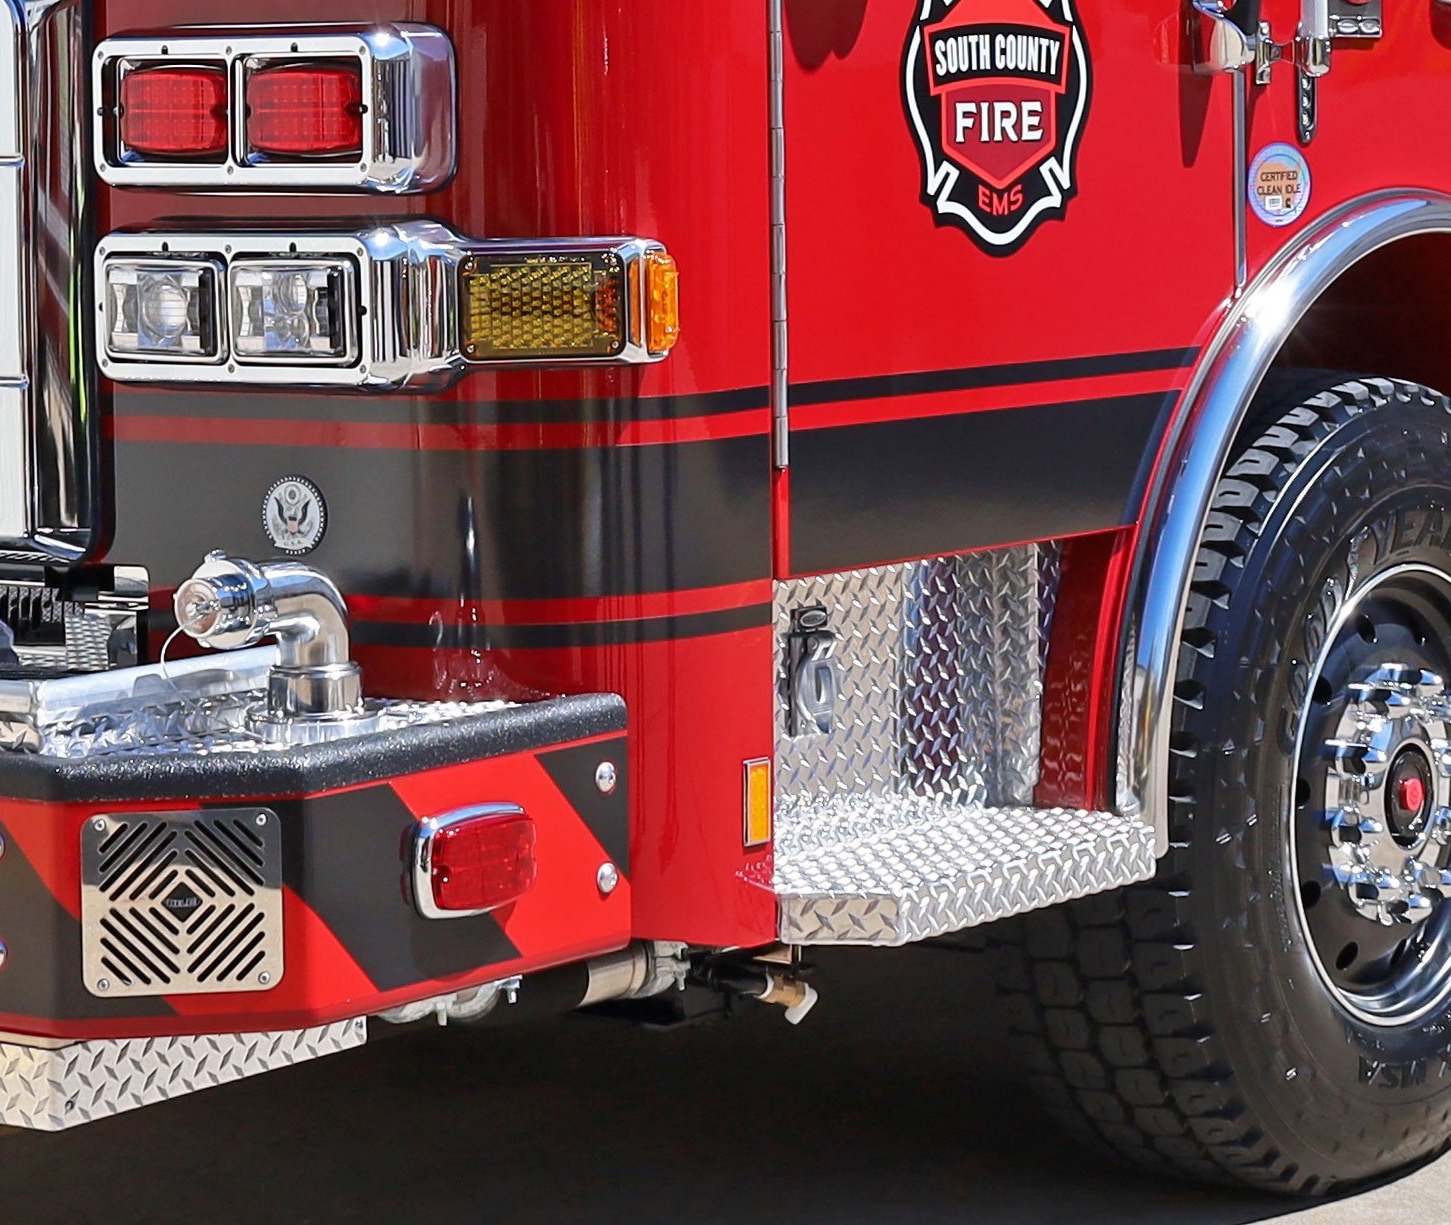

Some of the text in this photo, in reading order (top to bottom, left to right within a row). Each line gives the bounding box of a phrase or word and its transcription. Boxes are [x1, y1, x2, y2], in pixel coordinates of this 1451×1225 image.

[935, 34, 1060, 78] SOUTH COUNTY
[955, 101, 1043, 143] FIRE
[1257, 183, 1301, 195] CLEAN IDLE
[1261, 171, 1297, 181] CERTIFIED
[978, 184, 1023, 215] EMS
